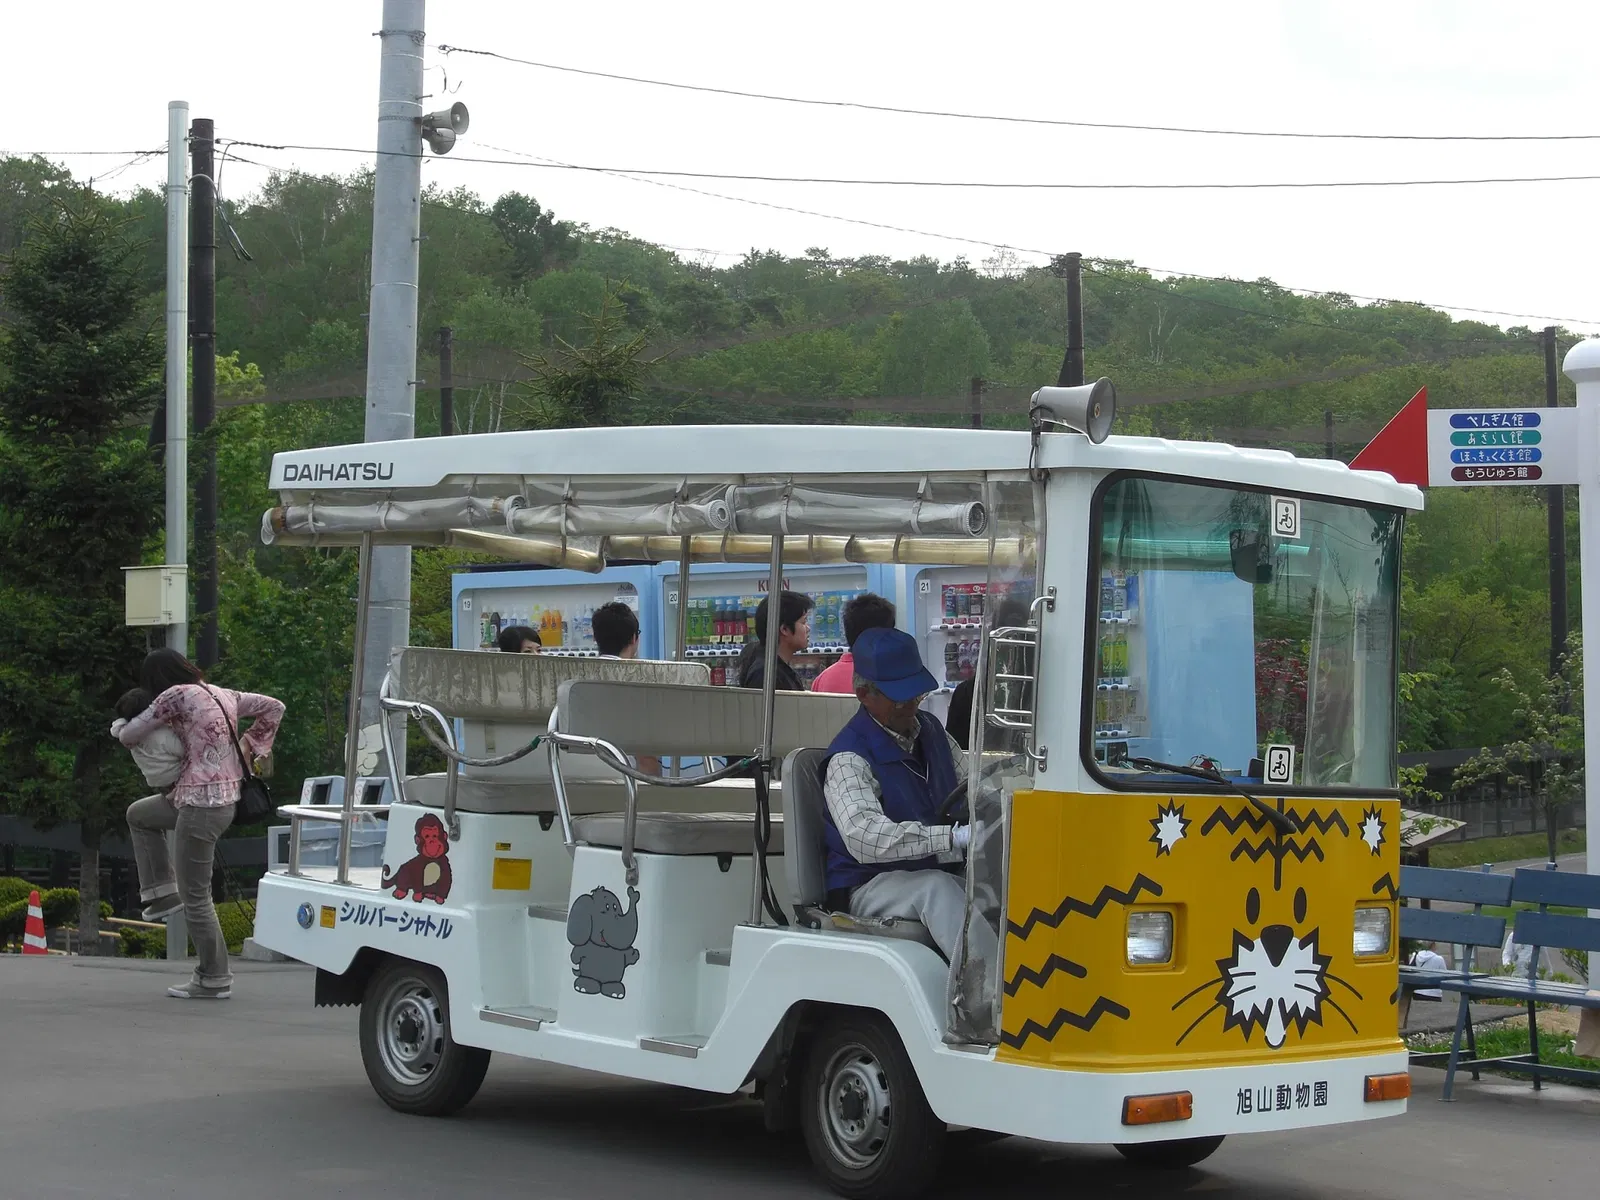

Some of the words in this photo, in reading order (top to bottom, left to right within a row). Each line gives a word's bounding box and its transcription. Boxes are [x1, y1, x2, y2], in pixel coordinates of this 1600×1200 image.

[1466, 413, 1524, 427] ぺんぎん館
[1467, 431, 1523, 445] あざらし館
[1460, 448, 1532, 462] ほっきょくぐま館
[283, 462, 394, 482] DAIHATSU
[1464, 467, 1528, 479] もうじゅう館
[758, 579, 790, 592] KIN
[921, 582, 929, 591] 21
[463, 600, 471, 609] 19
[669, 593, 678, 602] 20
[340, 900, 453, 940] シルバーシャトル
[1236, 1080, 1328, 1116] 旭山動物園
